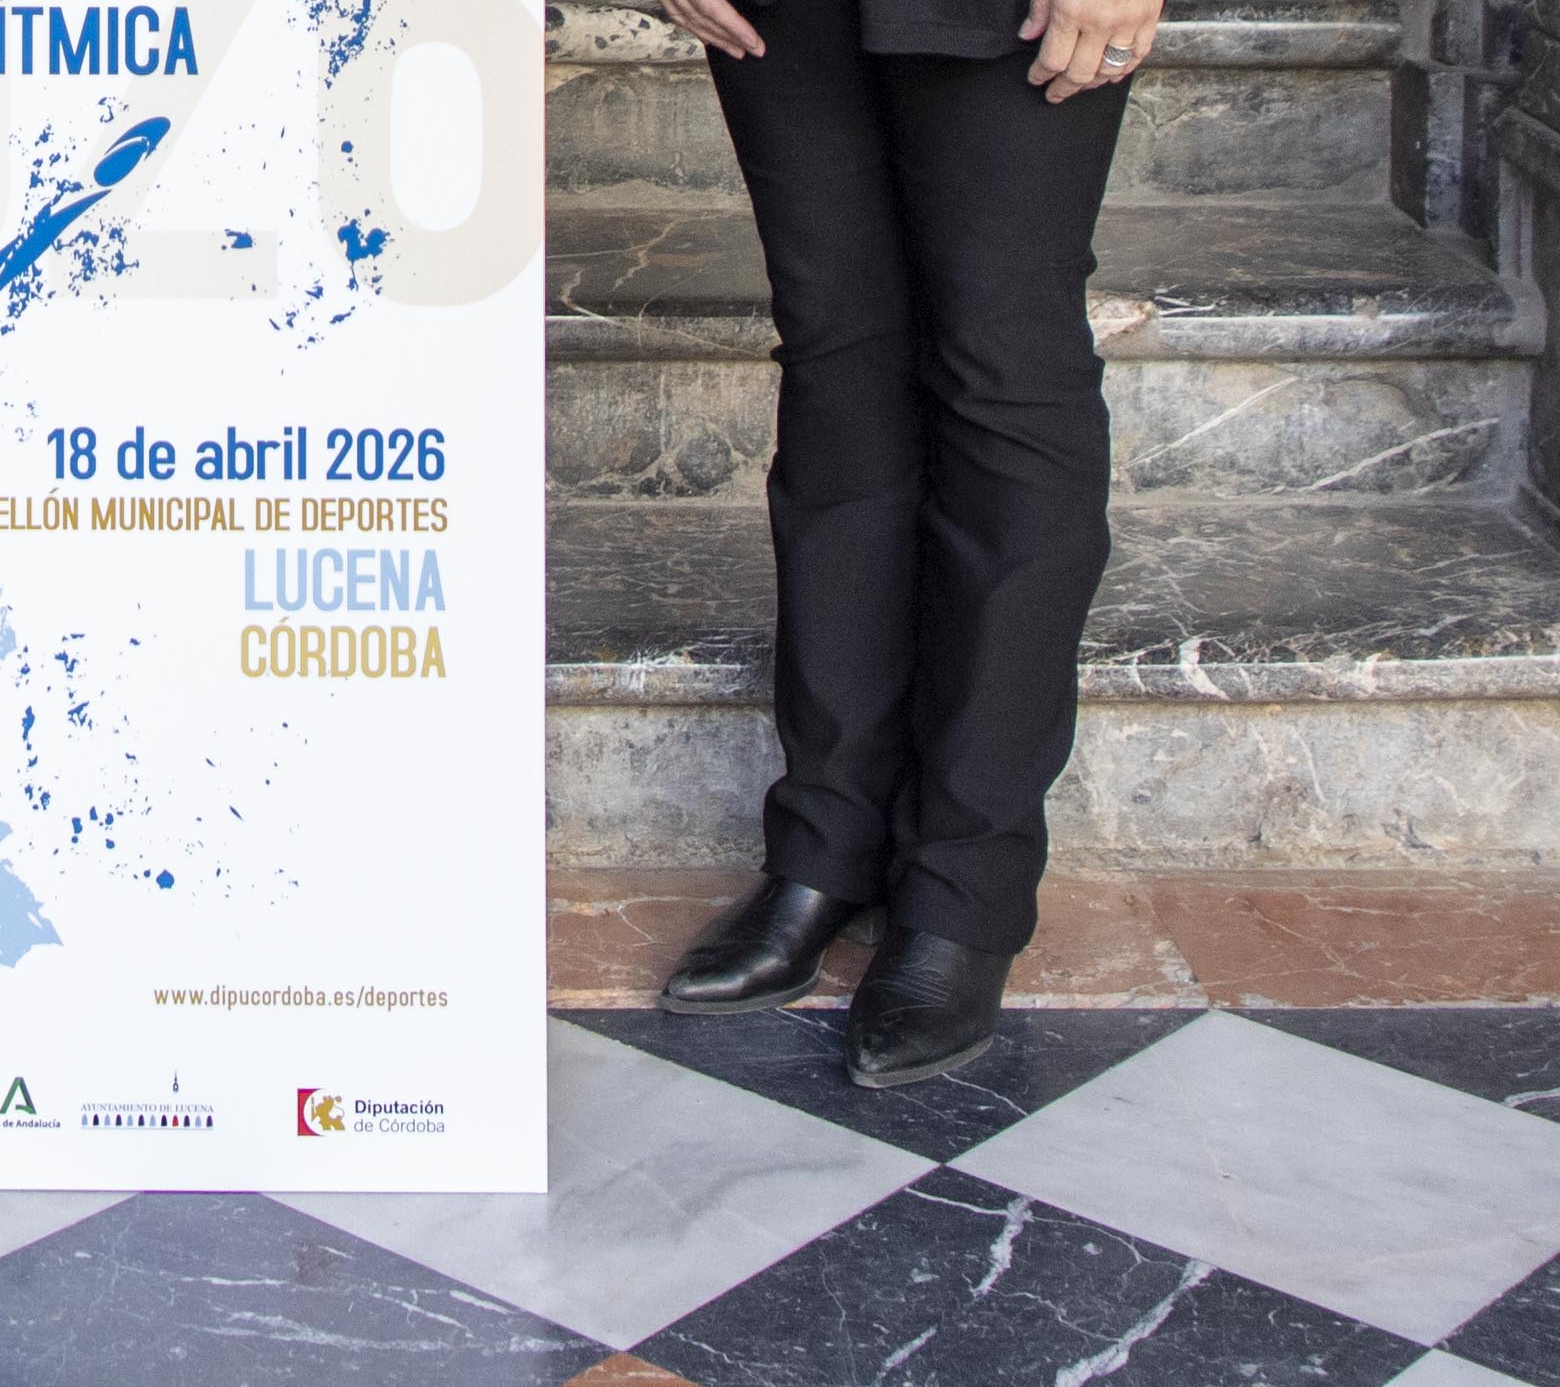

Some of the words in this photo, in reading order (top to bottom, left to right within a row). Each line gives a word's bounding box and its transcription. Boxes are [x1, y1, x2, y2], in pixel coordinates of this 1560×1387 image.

[47, 427, 97, 480] 18
[117, 426, 176, 480] de
[195, 426, 307, 481] abril
[326, 428, 445, 481] 2026
[91, 497, 245, 532] MUNICIPAL
[255, 498, 290, 532] DE
[301, 497, 448, 533] DEPORTES
[244, 548, 446, 612] LUCENA
[240, 617, 446, 679] CÓRDOBA
[153, 984, 448, 1011] www.dipucordoba.es/deportes
[80, 1103, 158, 1112] AYUNTAMIENTO
[160, 1104, 172, 1113] DE
[175, 1104, 214, 1113] LUCENA
[354, 1099, 444, 1117] Diputación
[2, 1119, 14, 1128] de
[16, 1119, 61, 1129] Andalucía
[353, 1118, 374, 1133] de
[378, 1118, 445, 1133] Córdoba
